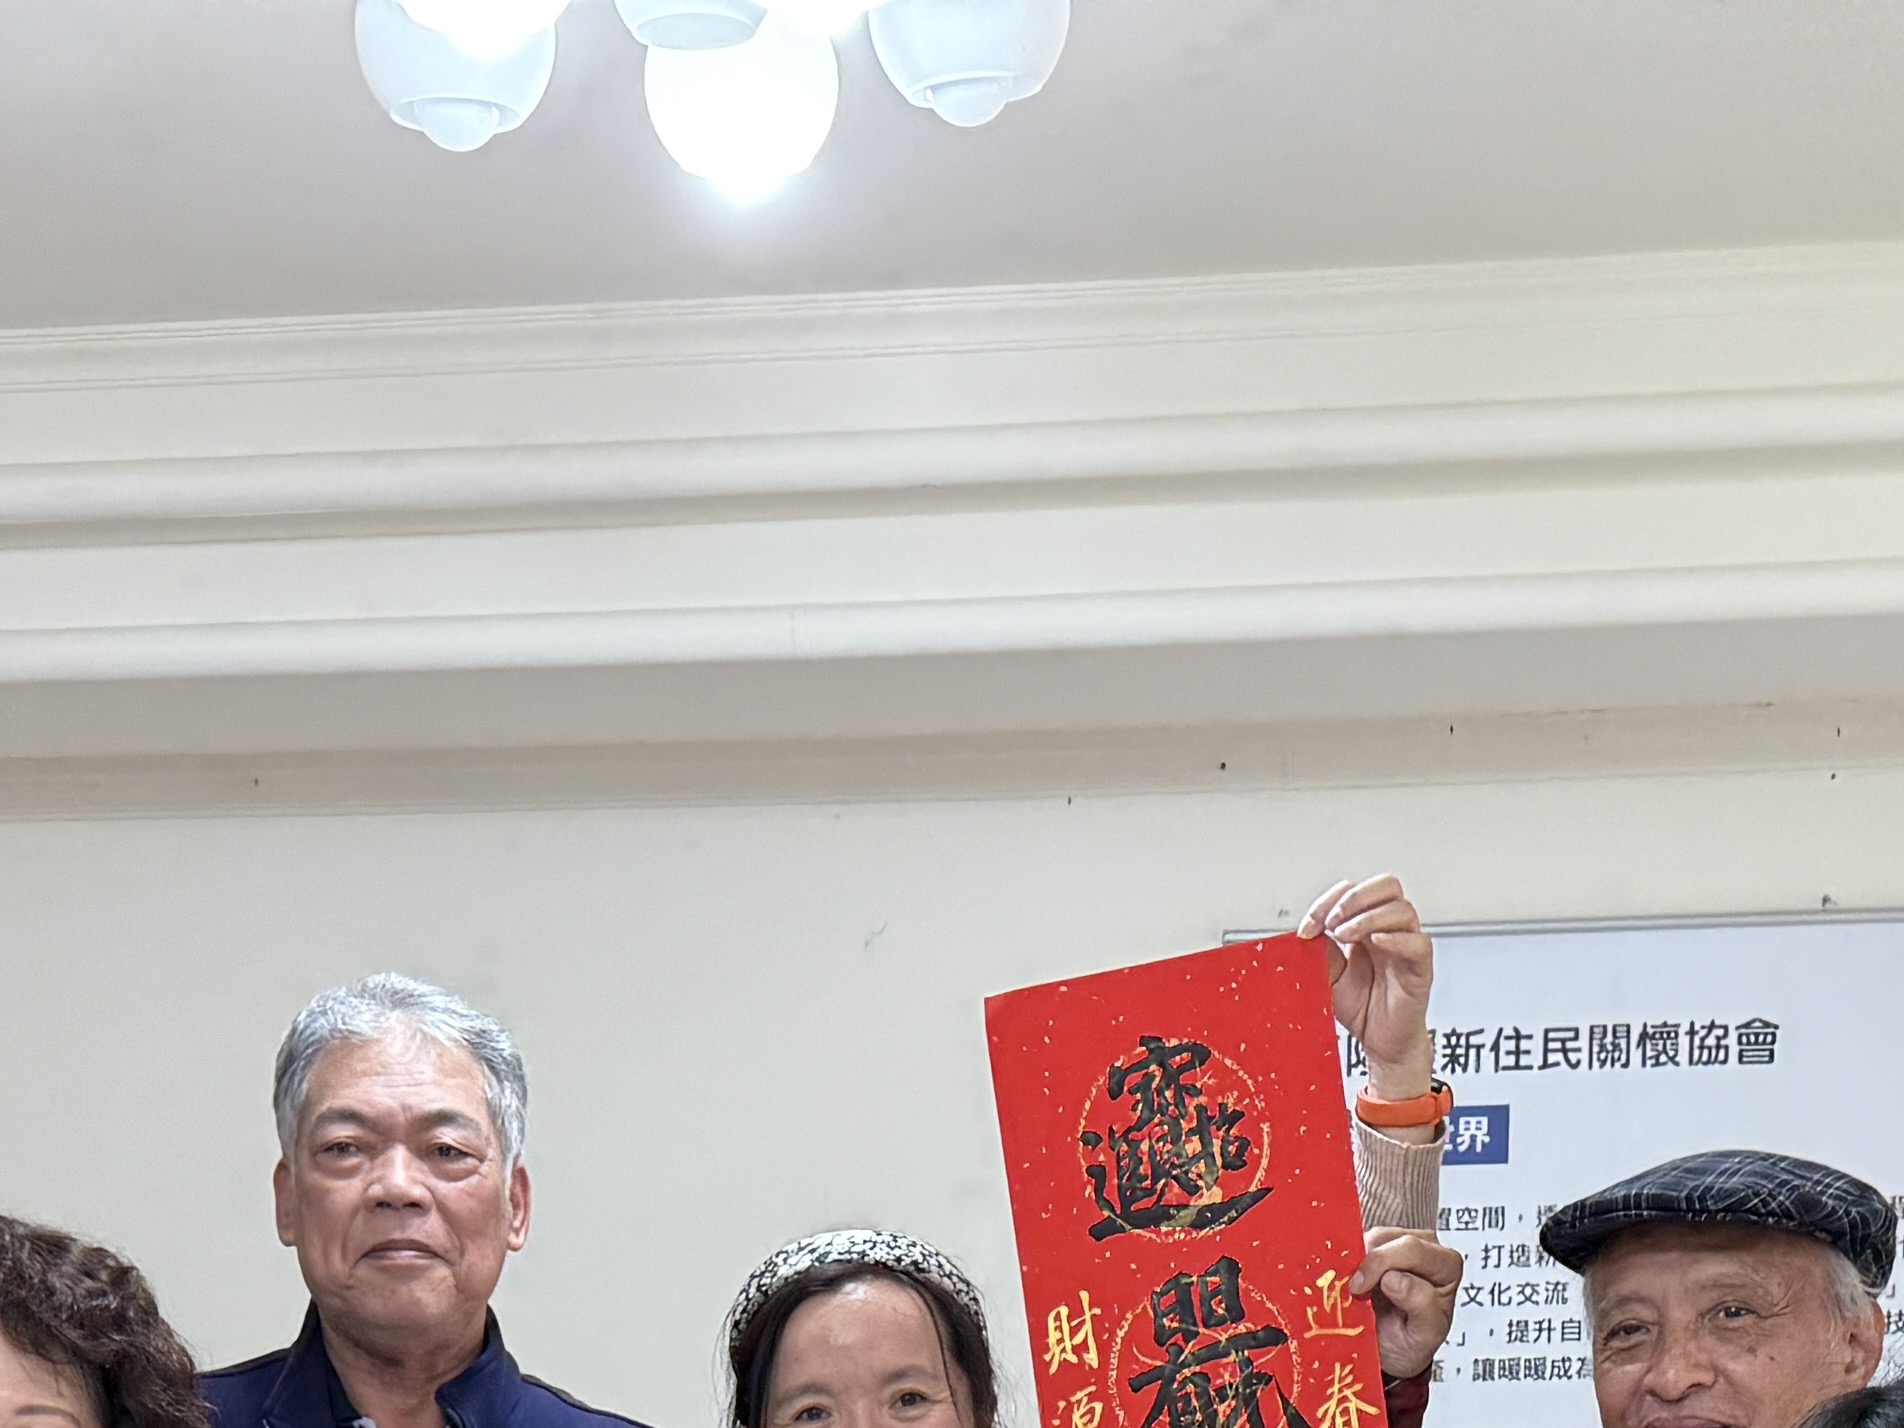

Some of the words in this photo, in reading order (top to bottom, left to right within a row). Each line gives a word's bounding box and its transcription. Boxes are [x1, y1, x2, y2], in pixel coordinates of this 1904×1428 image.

[1346, 1017, 1780, 1077] 新住民關懷協會
[1443, 1116, 1490, 1153] 界
[1460, 1281, 1569, 1307] 文化交流
